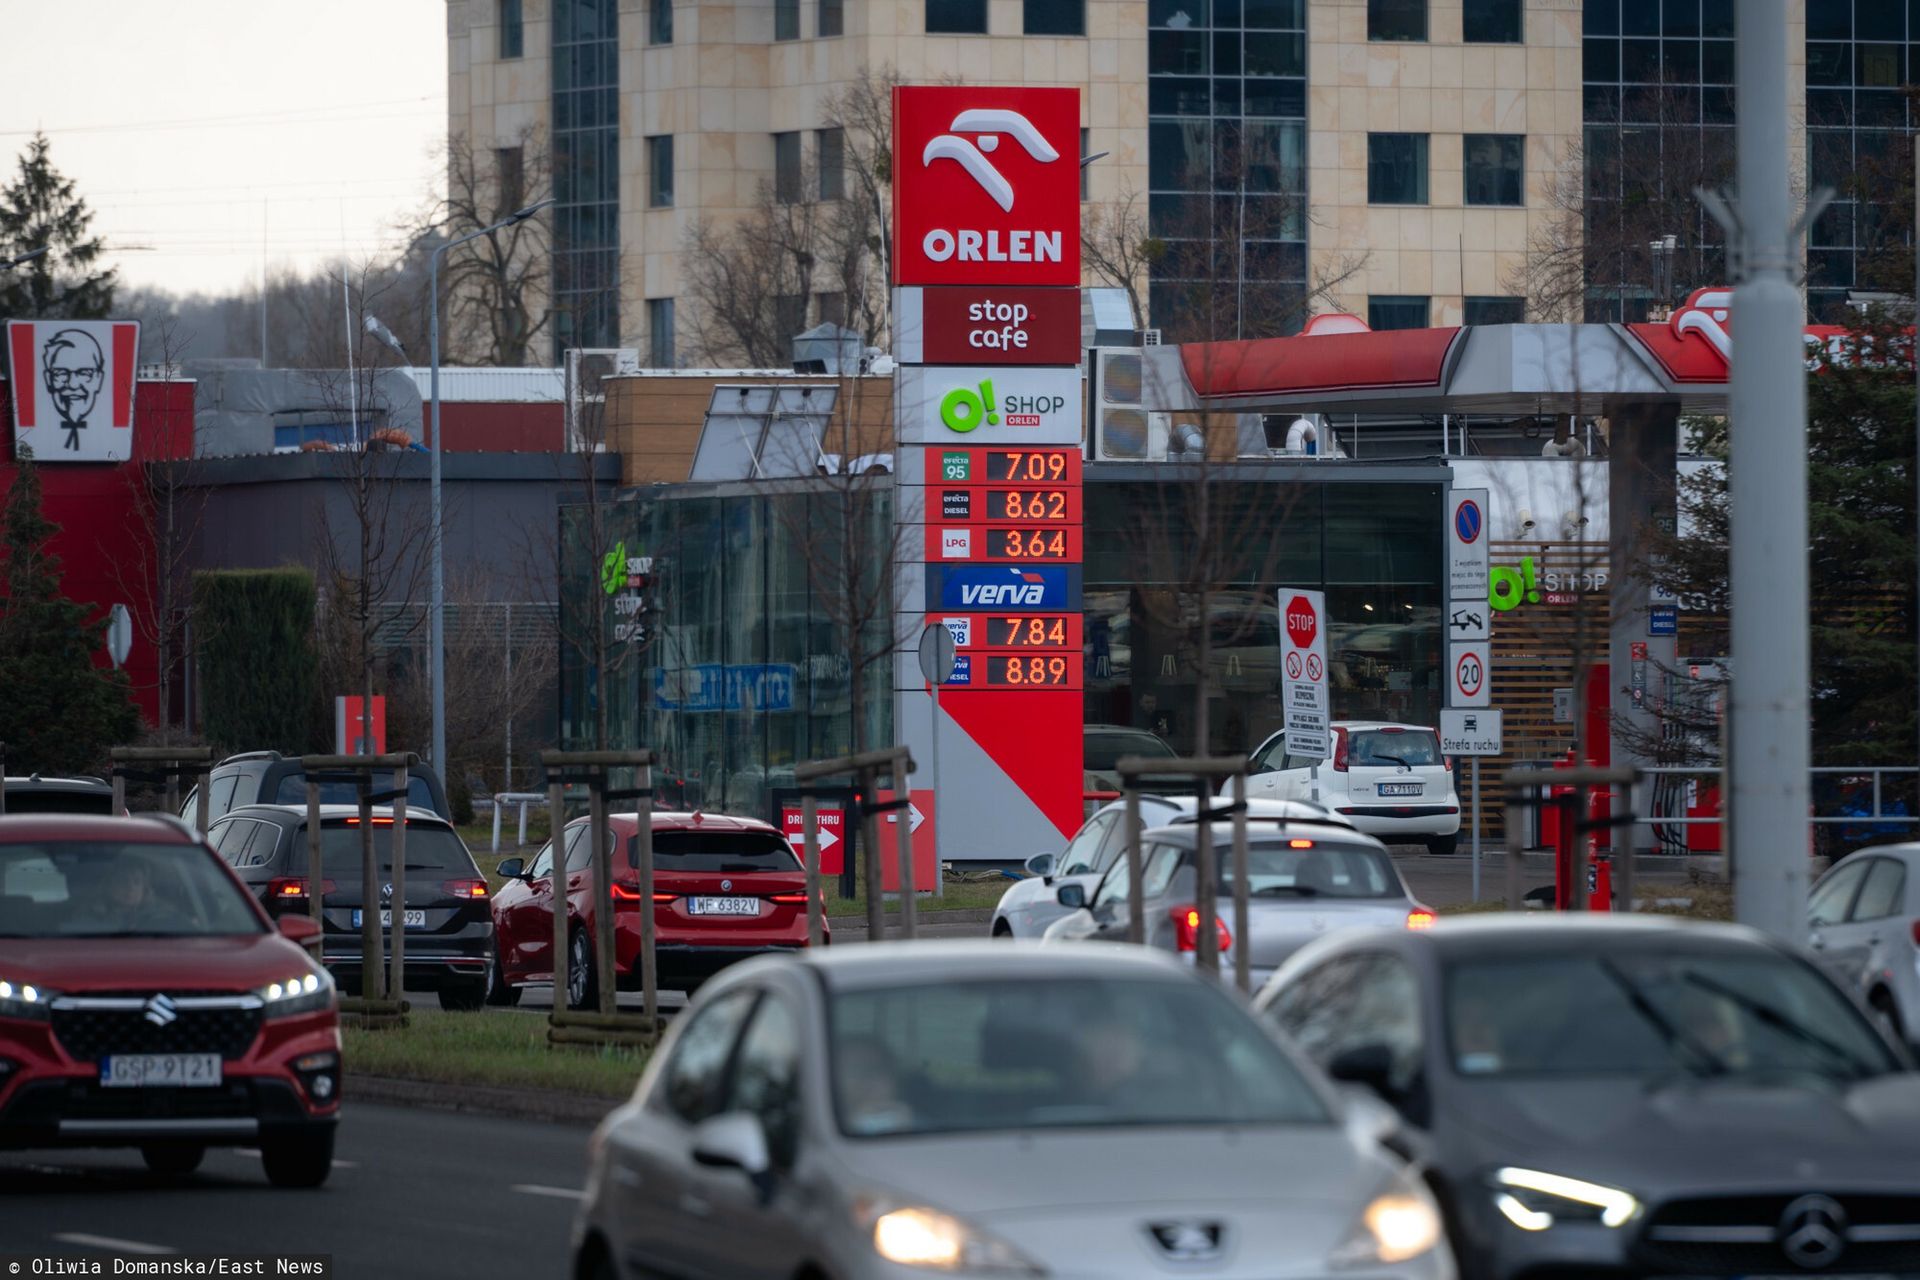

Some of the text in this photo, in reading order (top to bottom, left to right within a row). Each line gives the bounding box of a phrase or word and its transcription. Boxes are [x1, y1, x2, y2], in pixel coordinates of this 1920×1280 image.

[922, 228, 1062, 262] ORLEN
[969, 326, 1029, 351] cafe
[940, 377, 1064, 433] O! SHOP
[1008, 416, 1038, 425] ORLEN
[946, 453, 1065, 480] 95 7.09
[1006, 492, 1065, 518] 8.62
[945, 530, 1065, 557] LPG 3.64
[962, 584, 1045, 605] verva
[1006, 618, 1065, 645] 7.84
[1288, 613, 1314, 631] STOP
[1006, 657, 1066, 684] 8.89
[1461, 664, 1480, 685] 20
[1443, 738, 1499, 751] Strefa ruchu
[816, 815, 840, 825] THRU
[697, 899, 756, 912] WF 6382V
[115, 1055, 213, 1079] GSP 9T21
